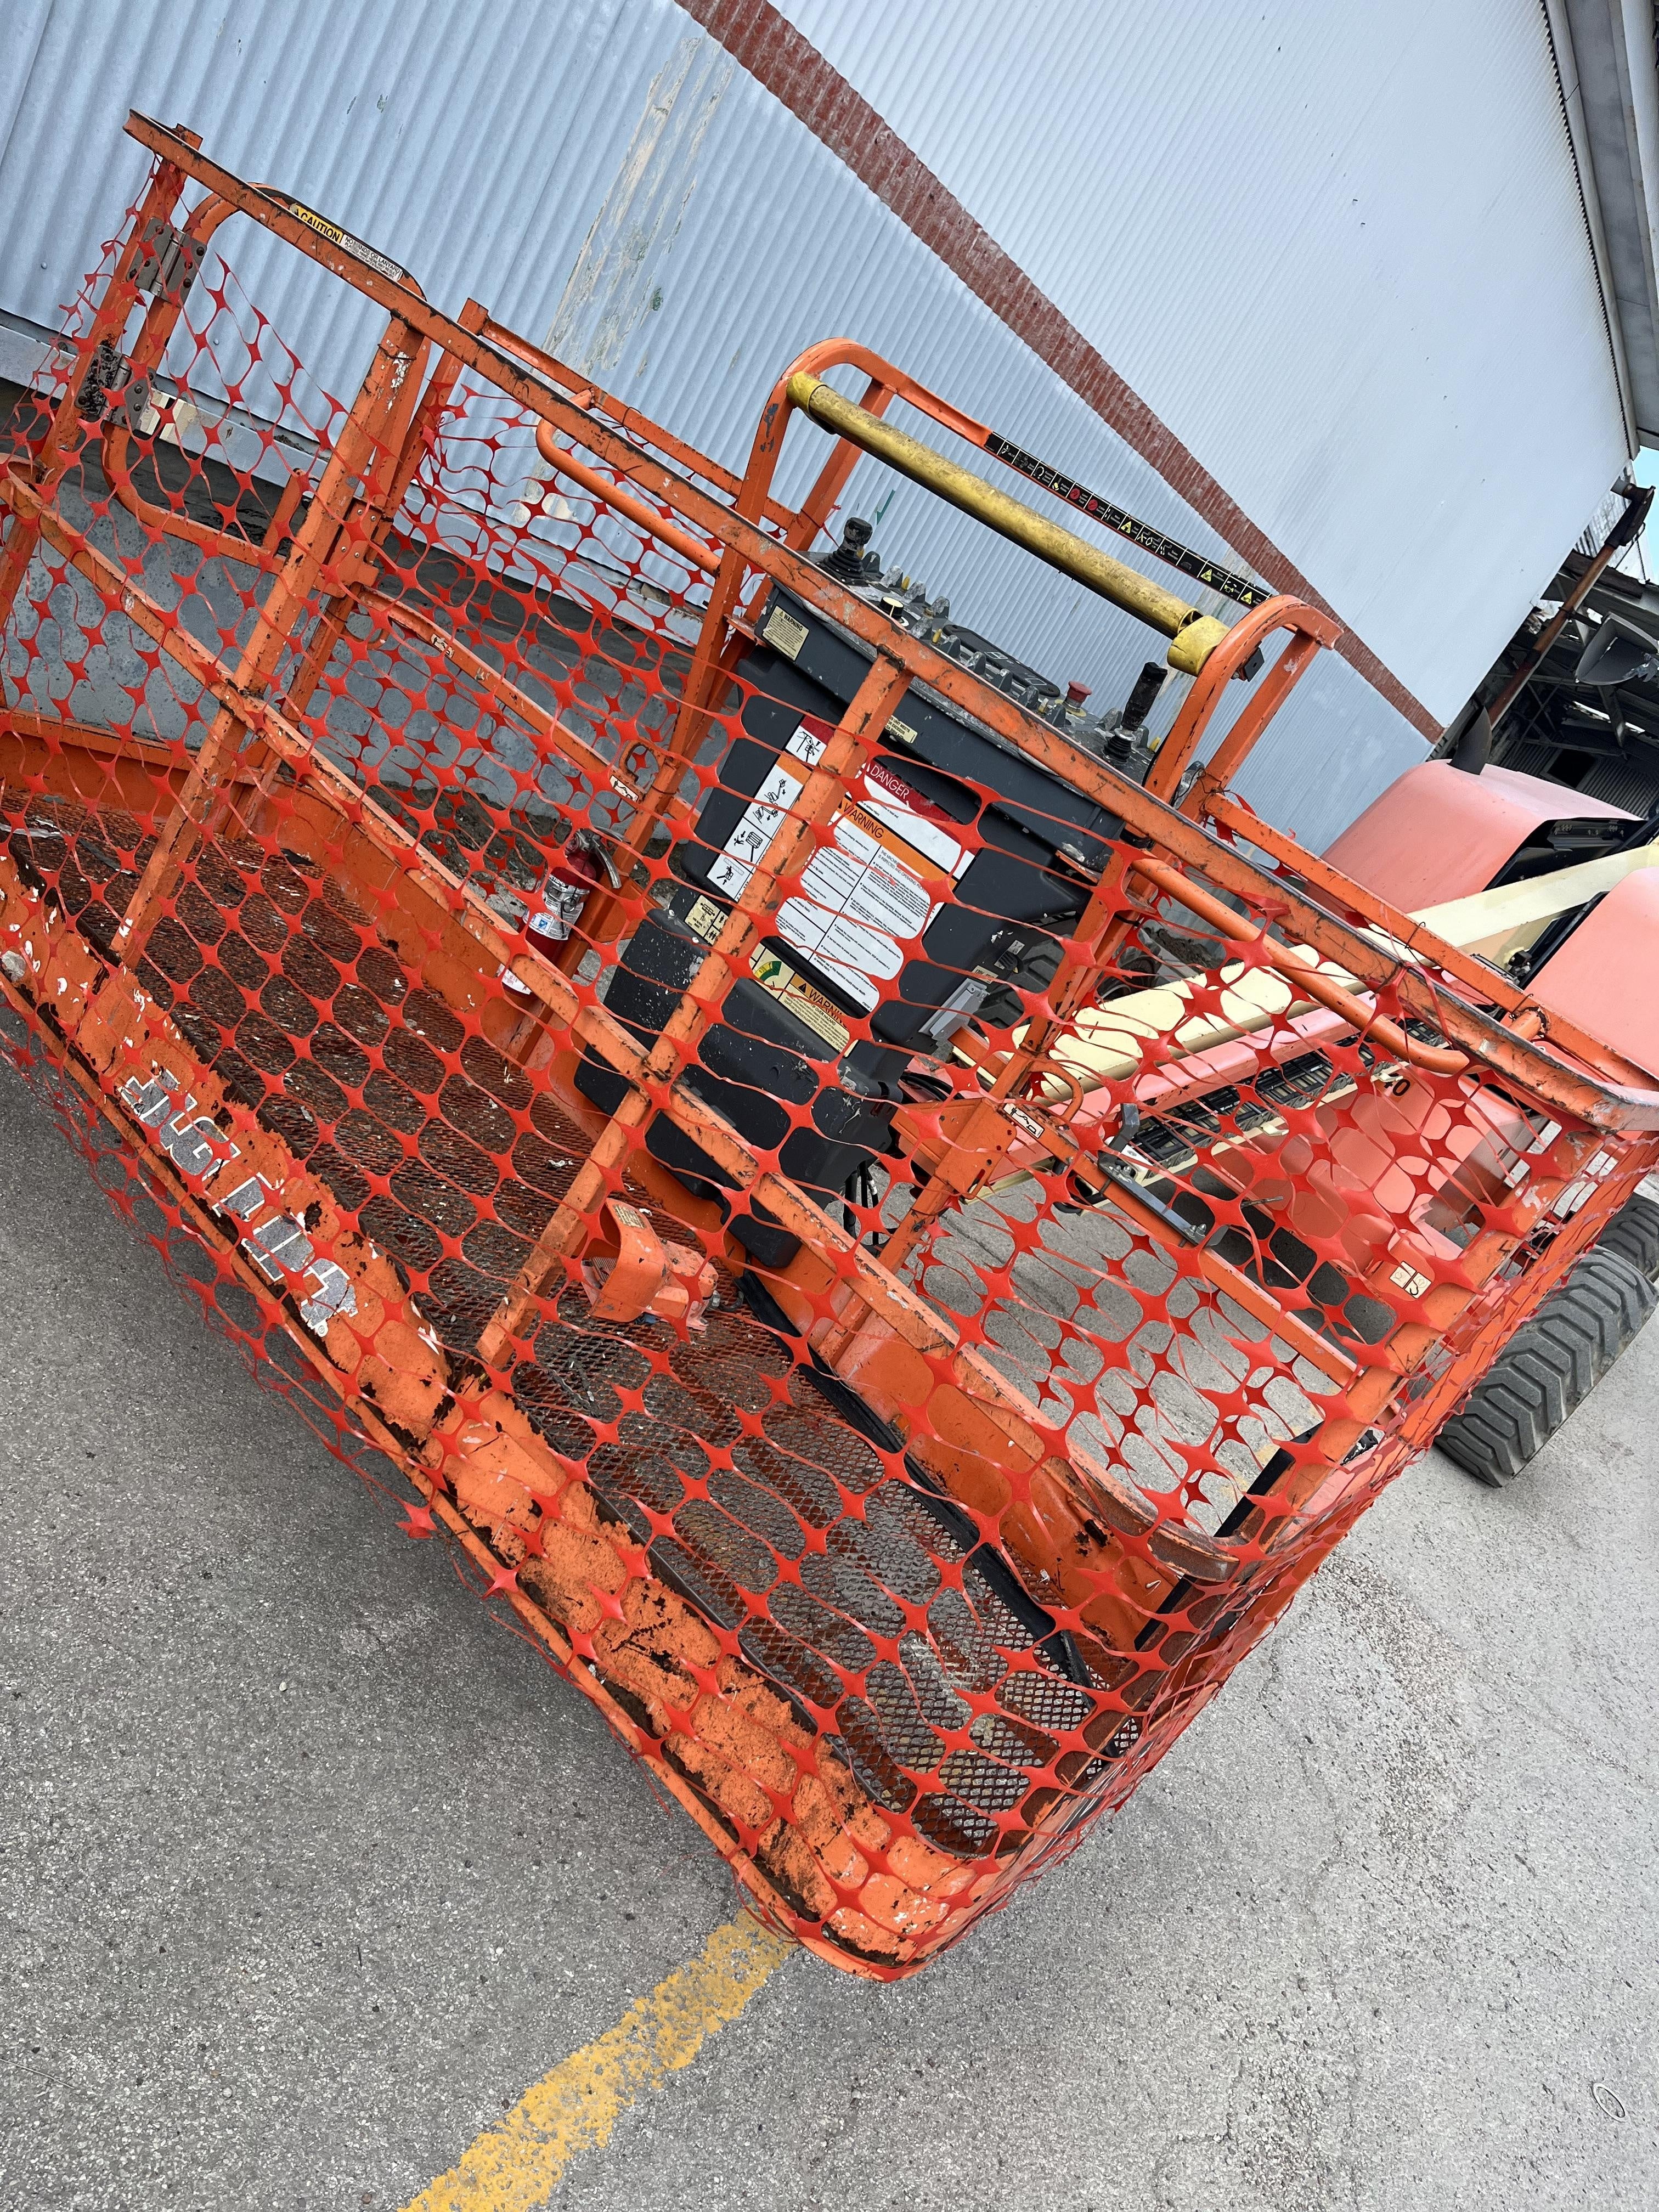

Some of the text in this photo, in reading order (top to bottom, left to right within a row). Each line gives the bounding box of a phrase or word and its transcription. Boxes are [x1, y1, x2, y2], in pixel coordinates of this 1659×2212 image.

[301, 213, 340, 241] CAUTION
[378, 257, 400, 274] LANYARD
[783, 613, 803, 631] WARNING
[870, 765, 909, 799] DANGER
[844, 803, 884, 838] WARNING
[809, 989, 847, 1028] WARNIN
[814, 1007, 824, 1015] OVER
[822, 1014, 836, 1026] HAZARD
